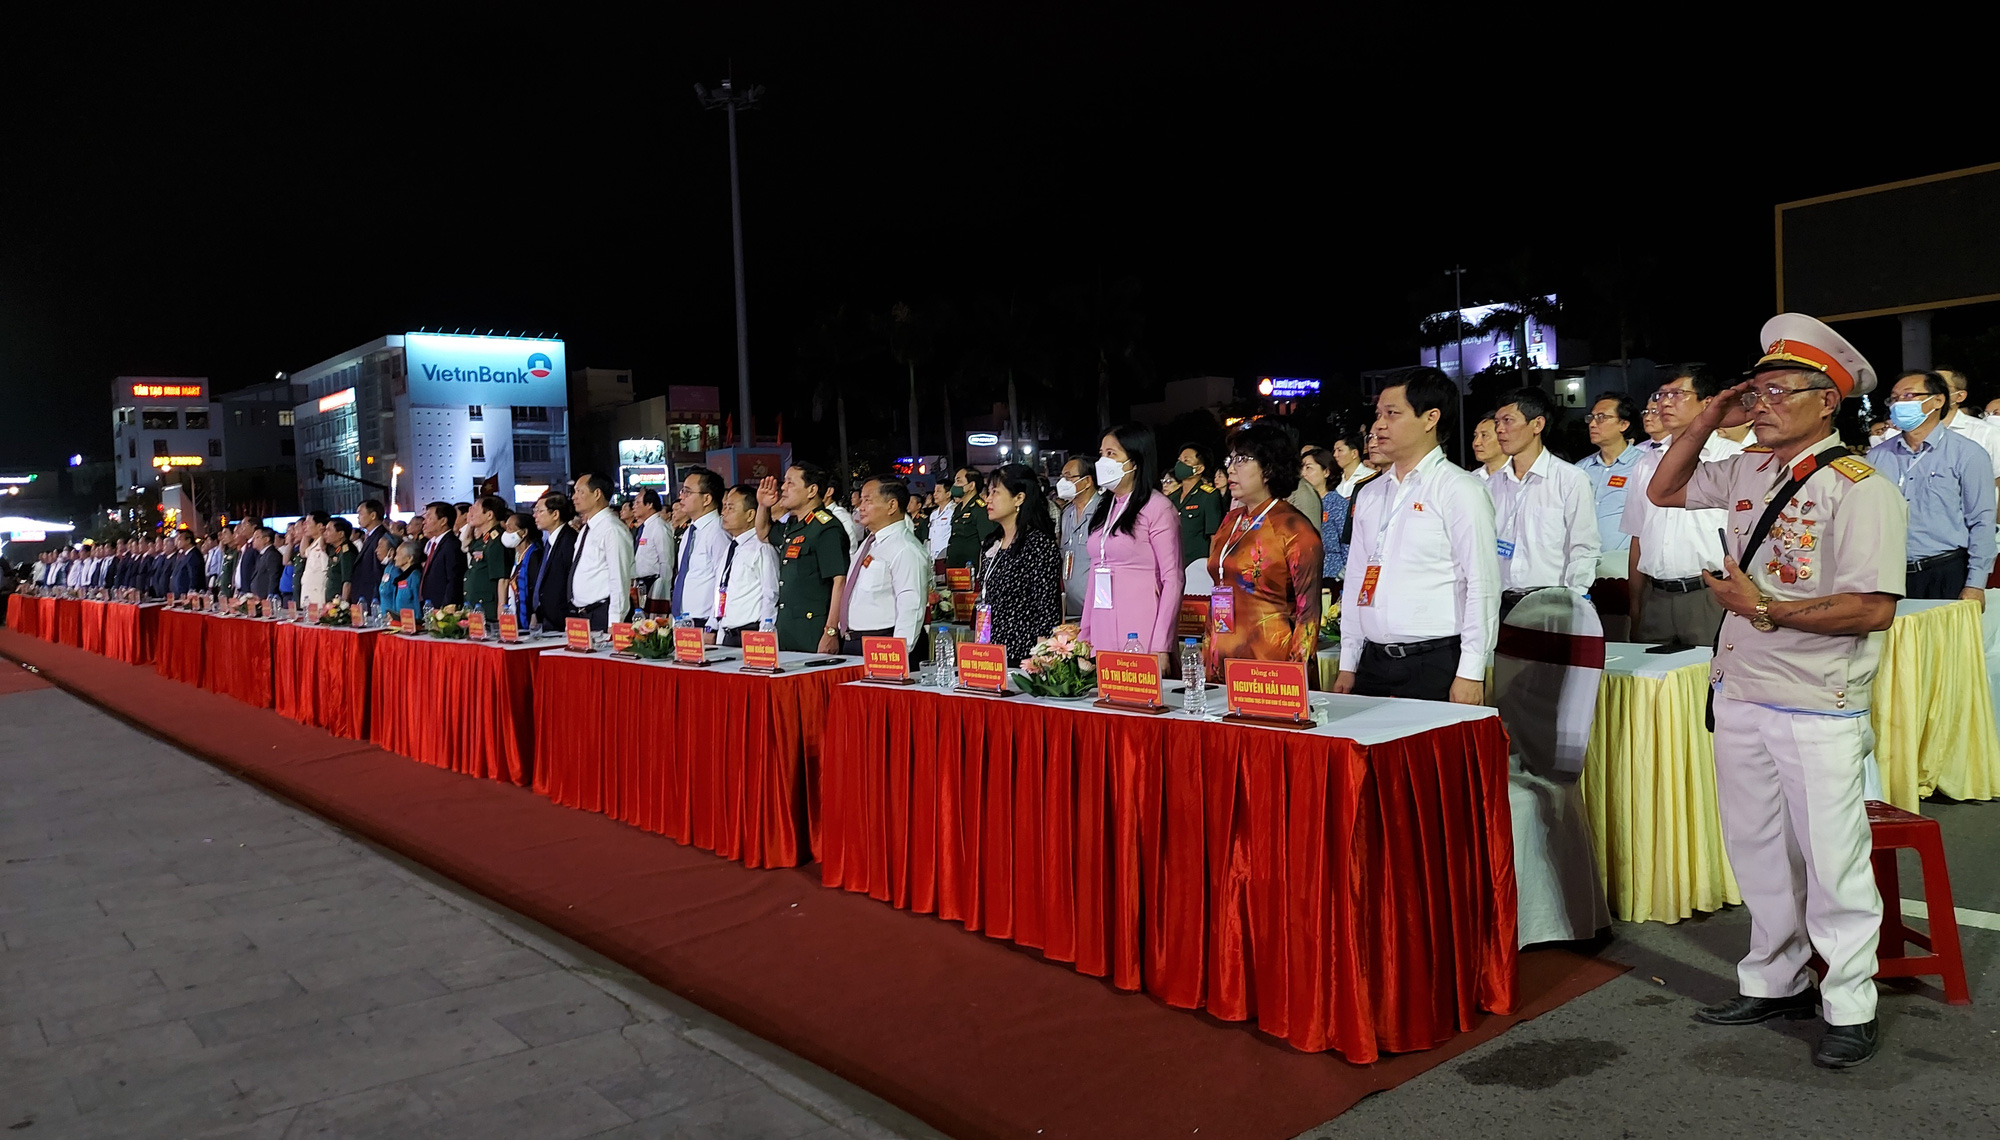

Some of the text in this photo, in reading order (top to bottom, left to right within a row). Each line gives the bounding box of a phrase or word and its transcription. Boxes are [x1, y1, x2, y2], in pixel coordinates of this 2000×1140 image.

[421, 363, 529, 384] VietinBank
[879, 653, 888, 663] THỊ
[1110, 670, 1121, 683] THỊ
[1122, 669, 1137, 683] BÍCH
[1138, 672, 1156, 685] CHÂU
[1251, 667, 1267, 677] Đồng
[1233, 678, 1300, 696] NGUYỄN HẢI NAM
